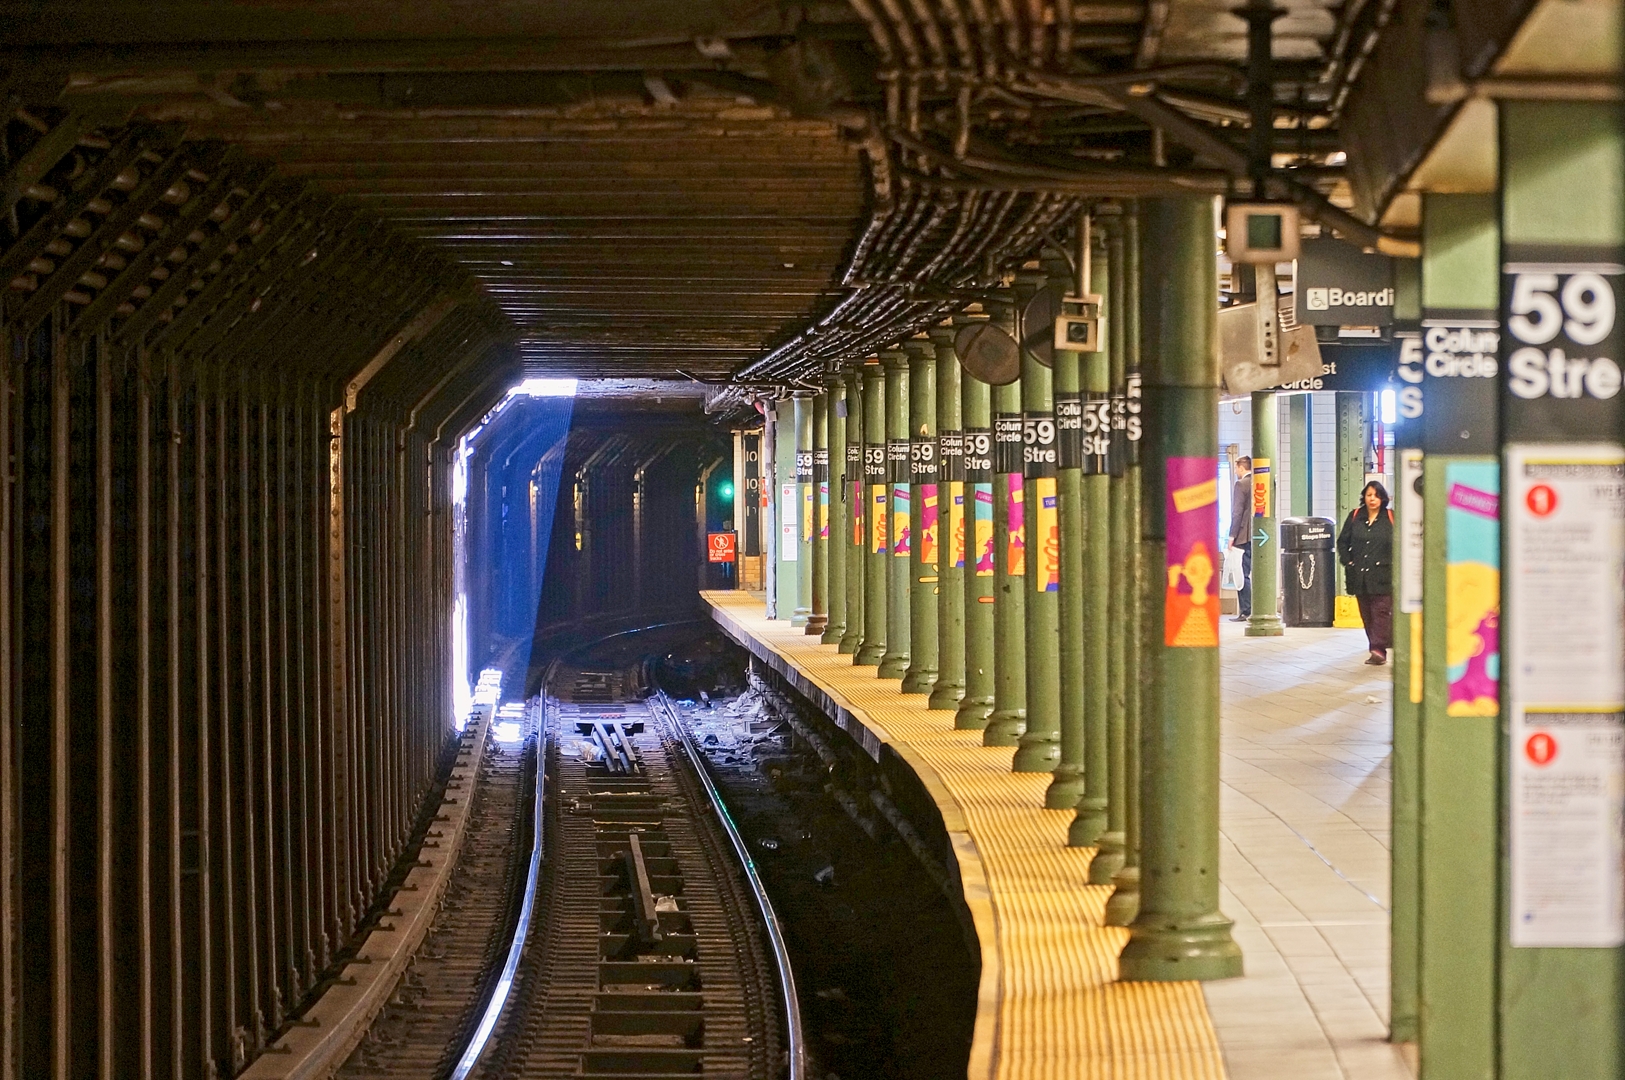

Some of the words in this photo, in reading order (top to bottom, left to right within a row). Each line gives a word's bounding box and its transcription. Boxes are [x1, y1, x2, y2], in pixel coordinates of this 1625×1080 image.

[1329, 287, 1394, 306] Boardi
[1508, 272, 1616, 345] 59
[1425, 352, 1498, 378] Circle
[1508, 346, 1621, 400] Stre
[1083, 403, 1110, 433] 59
[995, 432, 1021, 442] Circle
[1023, 421, 1055, 445] 59
[1126, 416, 1142, 441] S
[911, 444, 933, 461] 59
[941, 447, 962, 456] Circle
[964, 435, 989, 455] 59
[1082, 435, 1110, 455] Str
[746, 451, 757, 462] 10
[796, 455, 812, 467] 59
[865, 449, 884, 464] 59
[888, 453, 906, 461] Circle
[1023, 446, 1056, 463] Stre
[796, 467, 812, 476] Stre
[865, 465, 885, 475] Stre
[964, 457, 991, 470] Stre
[746, 478, 758, 489] 10
